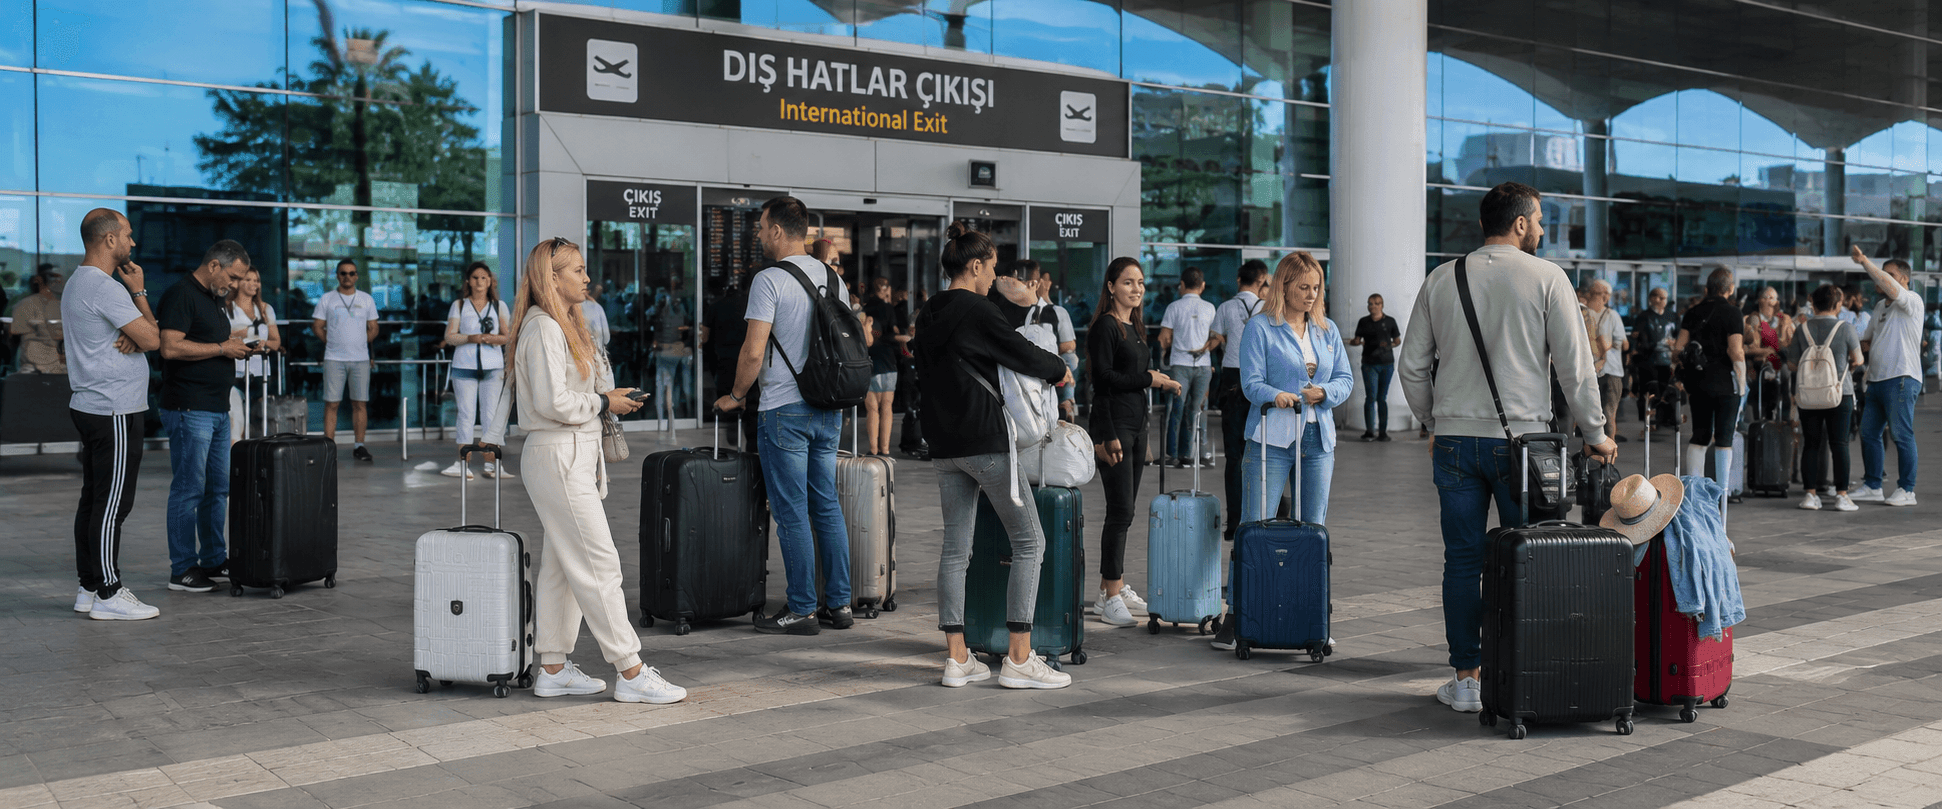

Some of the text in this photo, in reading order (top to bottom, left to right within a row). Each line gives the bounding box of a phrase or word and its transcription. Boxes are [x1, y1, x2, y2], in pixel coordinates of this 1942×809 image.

[723, 49, 994, 114] DIŞ HATLAR ÇIKIŞI
[780, 98, 948, 133] International Exit
[623, 188, 662, 207] ÇIKIŞ
[629, 206, 658, 219] EXIT
[1059, 228, 1080, 238] EXIT
